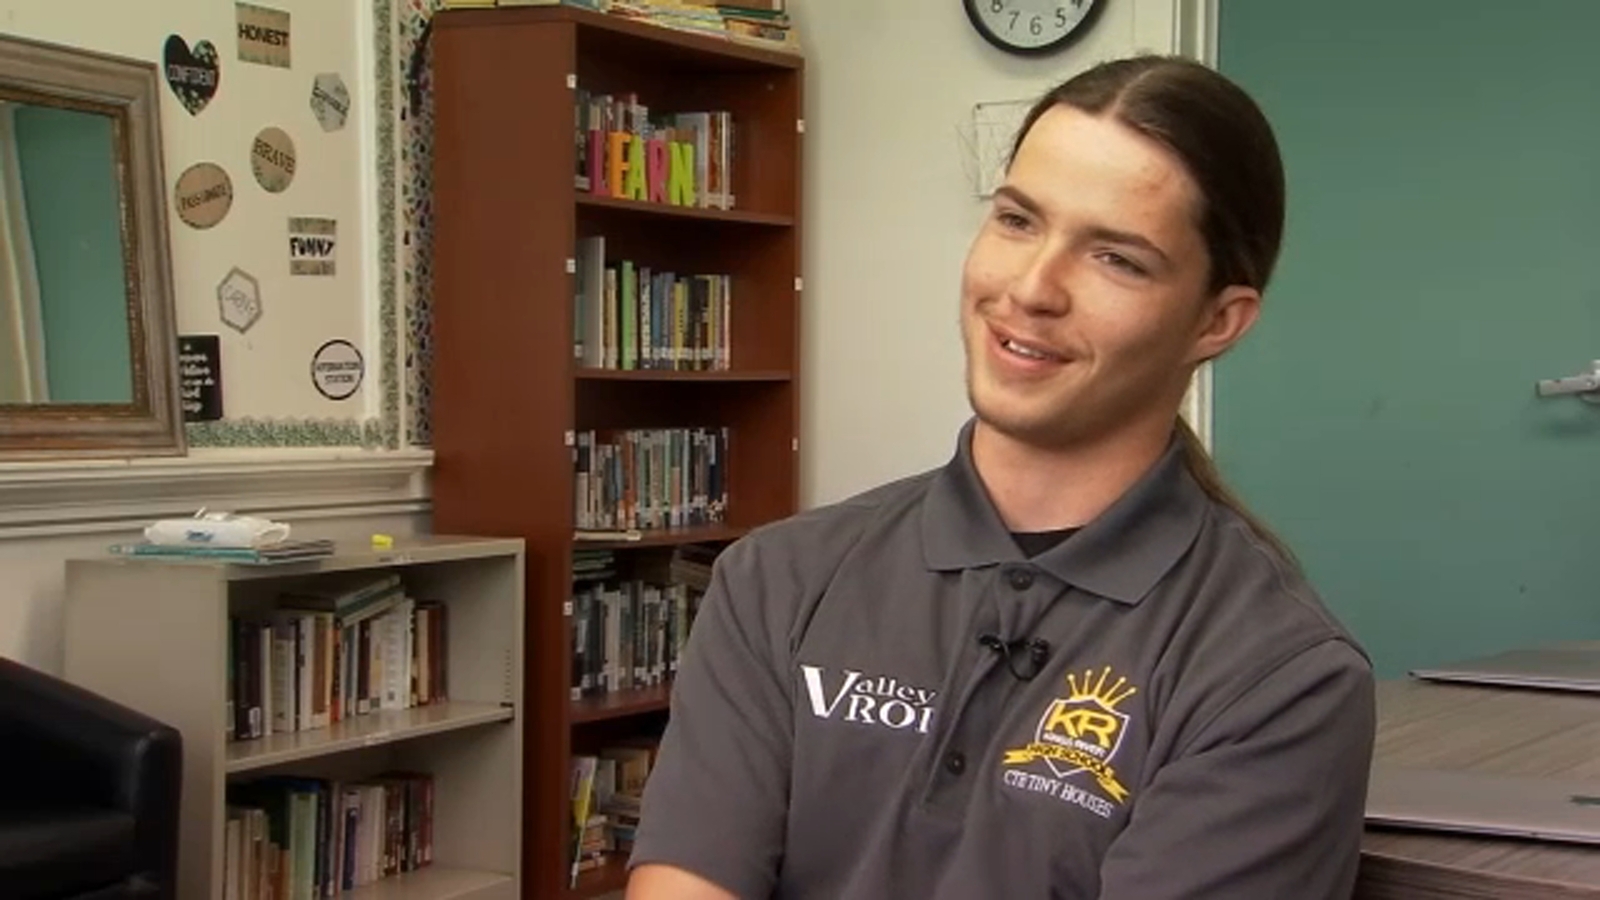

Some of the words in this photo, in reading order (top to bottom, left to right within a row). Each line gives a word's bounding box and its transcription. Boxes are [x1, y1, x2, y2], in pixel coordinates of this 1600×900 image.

[237, 23, 289, 47] HONEST
[1009, 11, 1020, 30] 7
[1029, 16, 1042, 36] 6
[1055, 7, 1066, 28] 5
[252, 137, 296, 174] BRAVE
[590, 129, 697, 207] LEARN
[289, 236, 335, 257] FUNNY
[801, 665, 937, 719] Valley
[845, 695, 936, 734] ROI
[1044, 702, 1118, 749] KR
[1027, 773, 1062, 797] TINY
[1060, 783, 1114, 819] HOUSES
